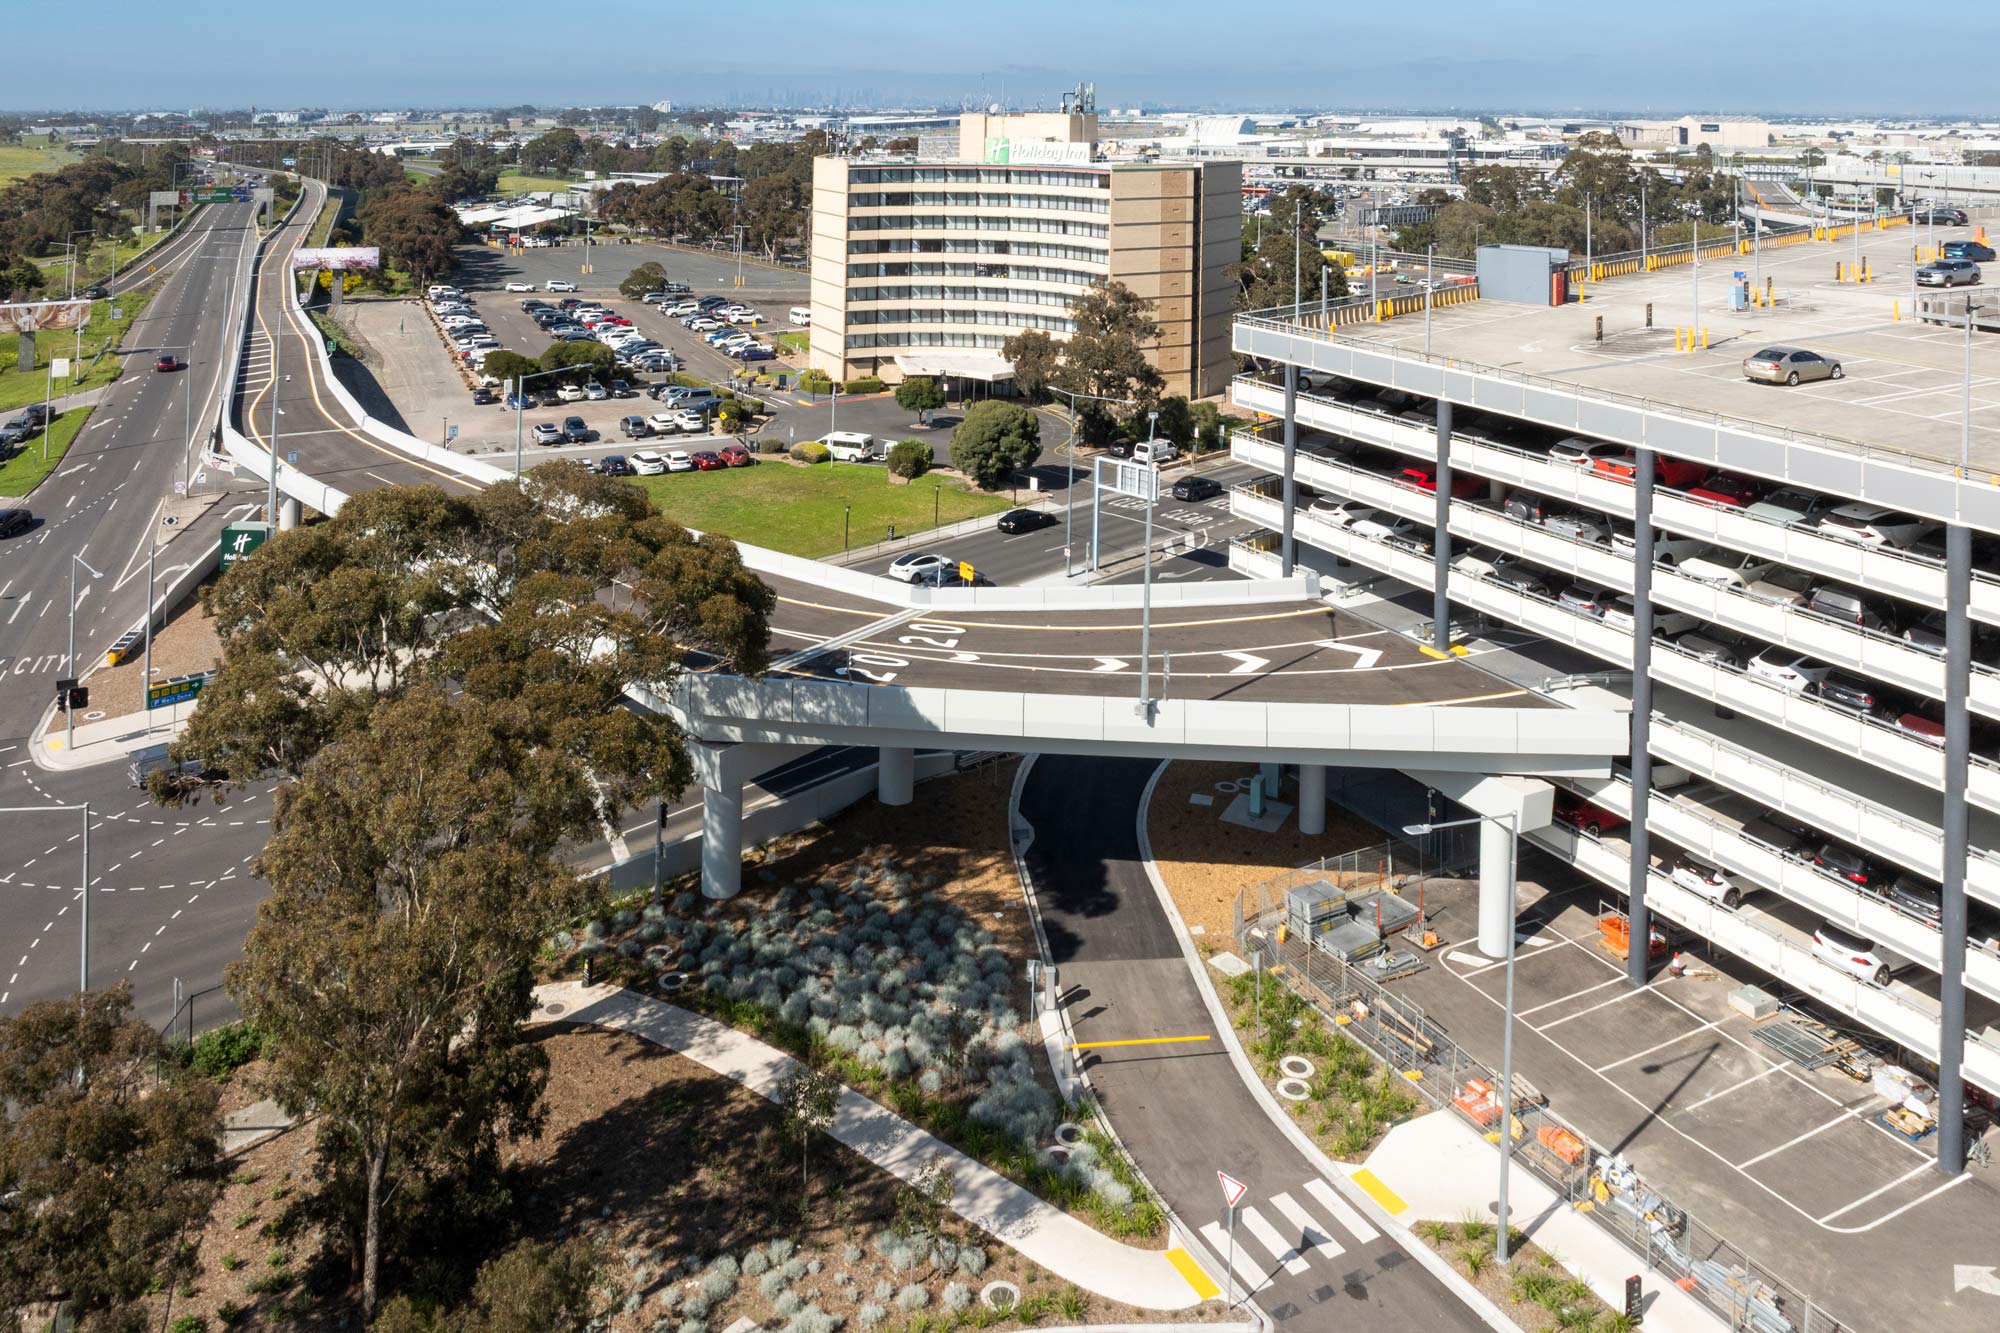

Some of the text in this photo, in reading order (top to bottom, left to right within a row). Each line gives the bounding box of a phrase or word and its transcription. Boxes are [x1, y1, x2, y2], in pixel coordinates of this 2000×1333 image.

[1012, 143, 1063, 162] Holiday
[1065, 144, 1087, 160] Inn
[1160, 508, 1214, 526] CLEAR
[898, 623, 967, 649] 20
[14, 654, 72, 675] CITY
